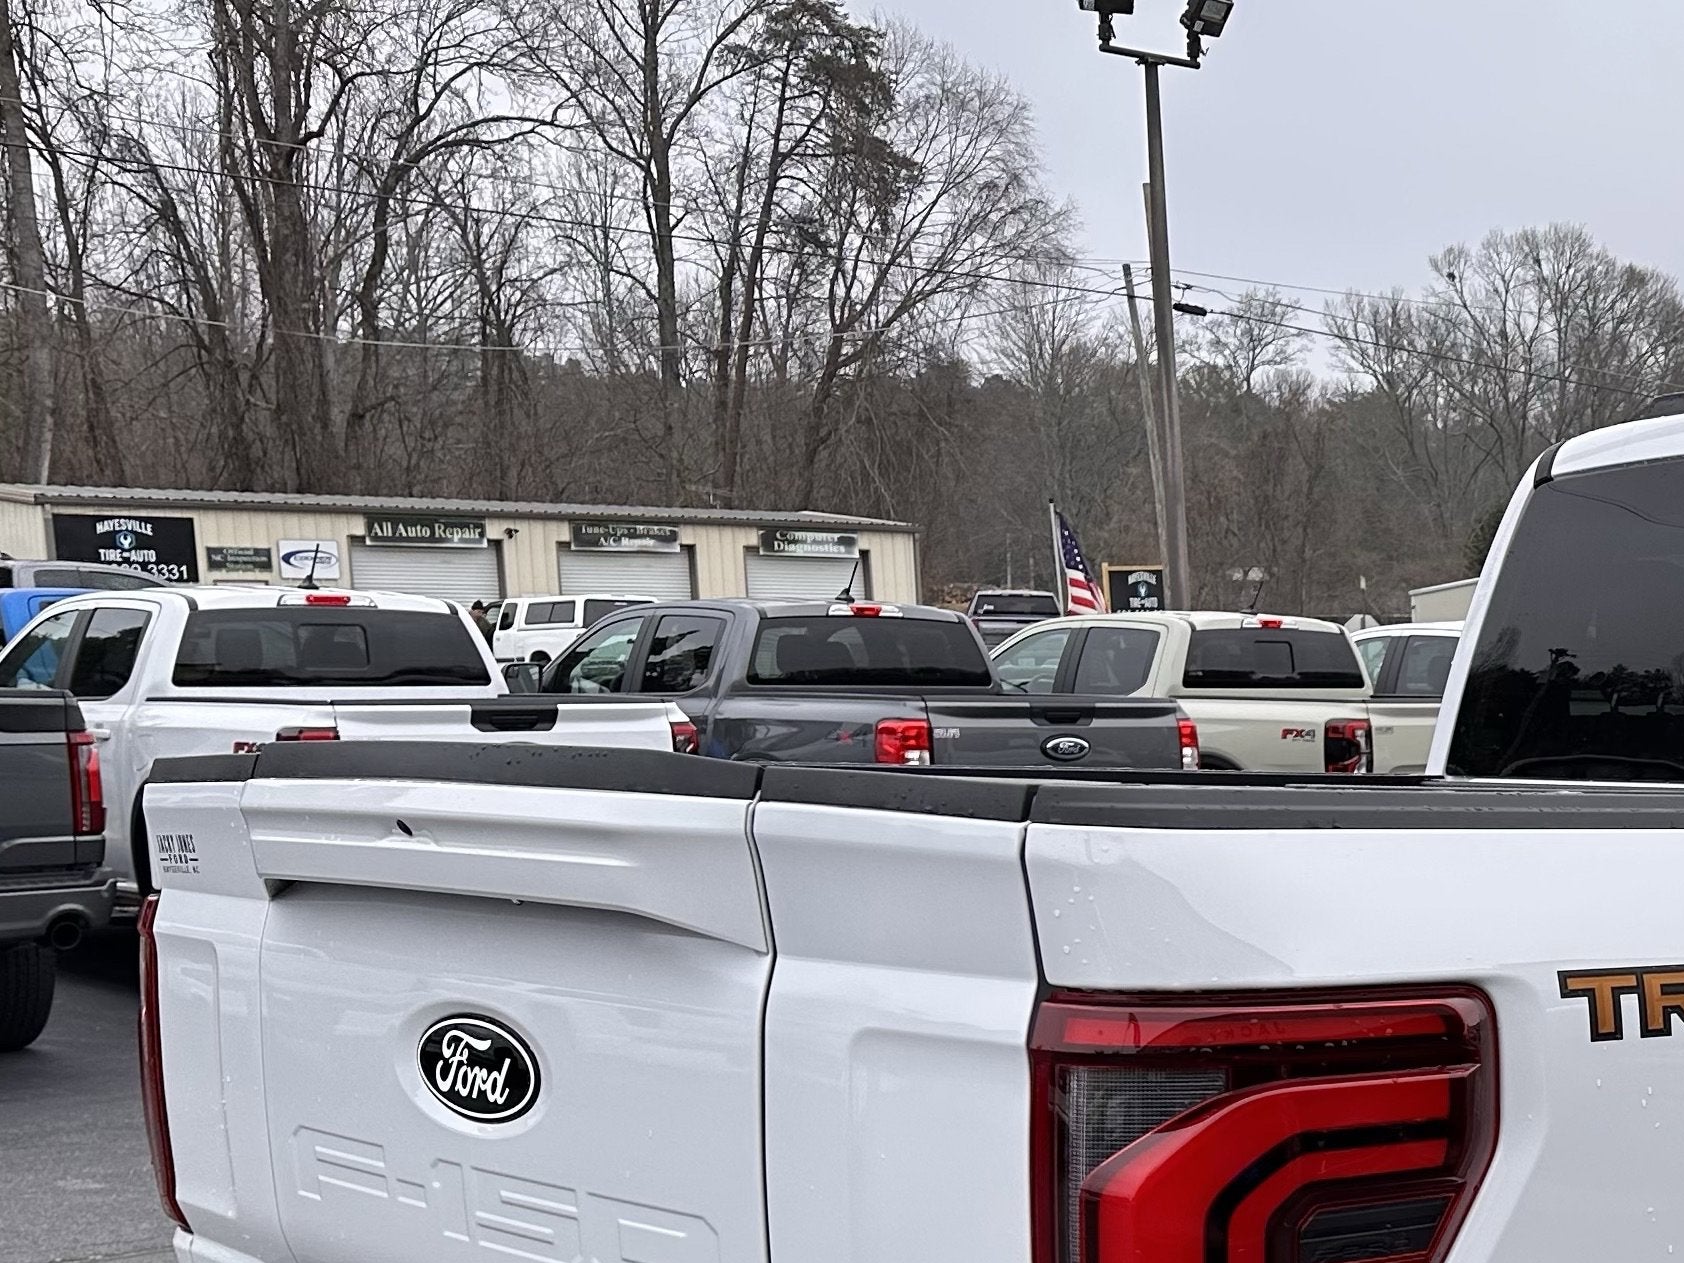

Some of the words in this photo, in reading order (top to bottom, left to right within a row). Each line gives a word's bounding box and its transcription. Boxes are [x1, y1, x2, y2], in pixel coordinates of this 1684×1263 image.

[95, 518, 153, 536] HAYESVILLE
[371, 522, 392, 537] All
[396, 523, 430, 537] Auto
[434, 524, 482, 542] Repair
[776, 530, 838, 543] Computer
[774, 541, 845, 553] Diagnostics
[1281, 728, 1316, 740] FX4
[168, 853, 189, 864] FORD
[435, 1029, 512, 1105] Ford
